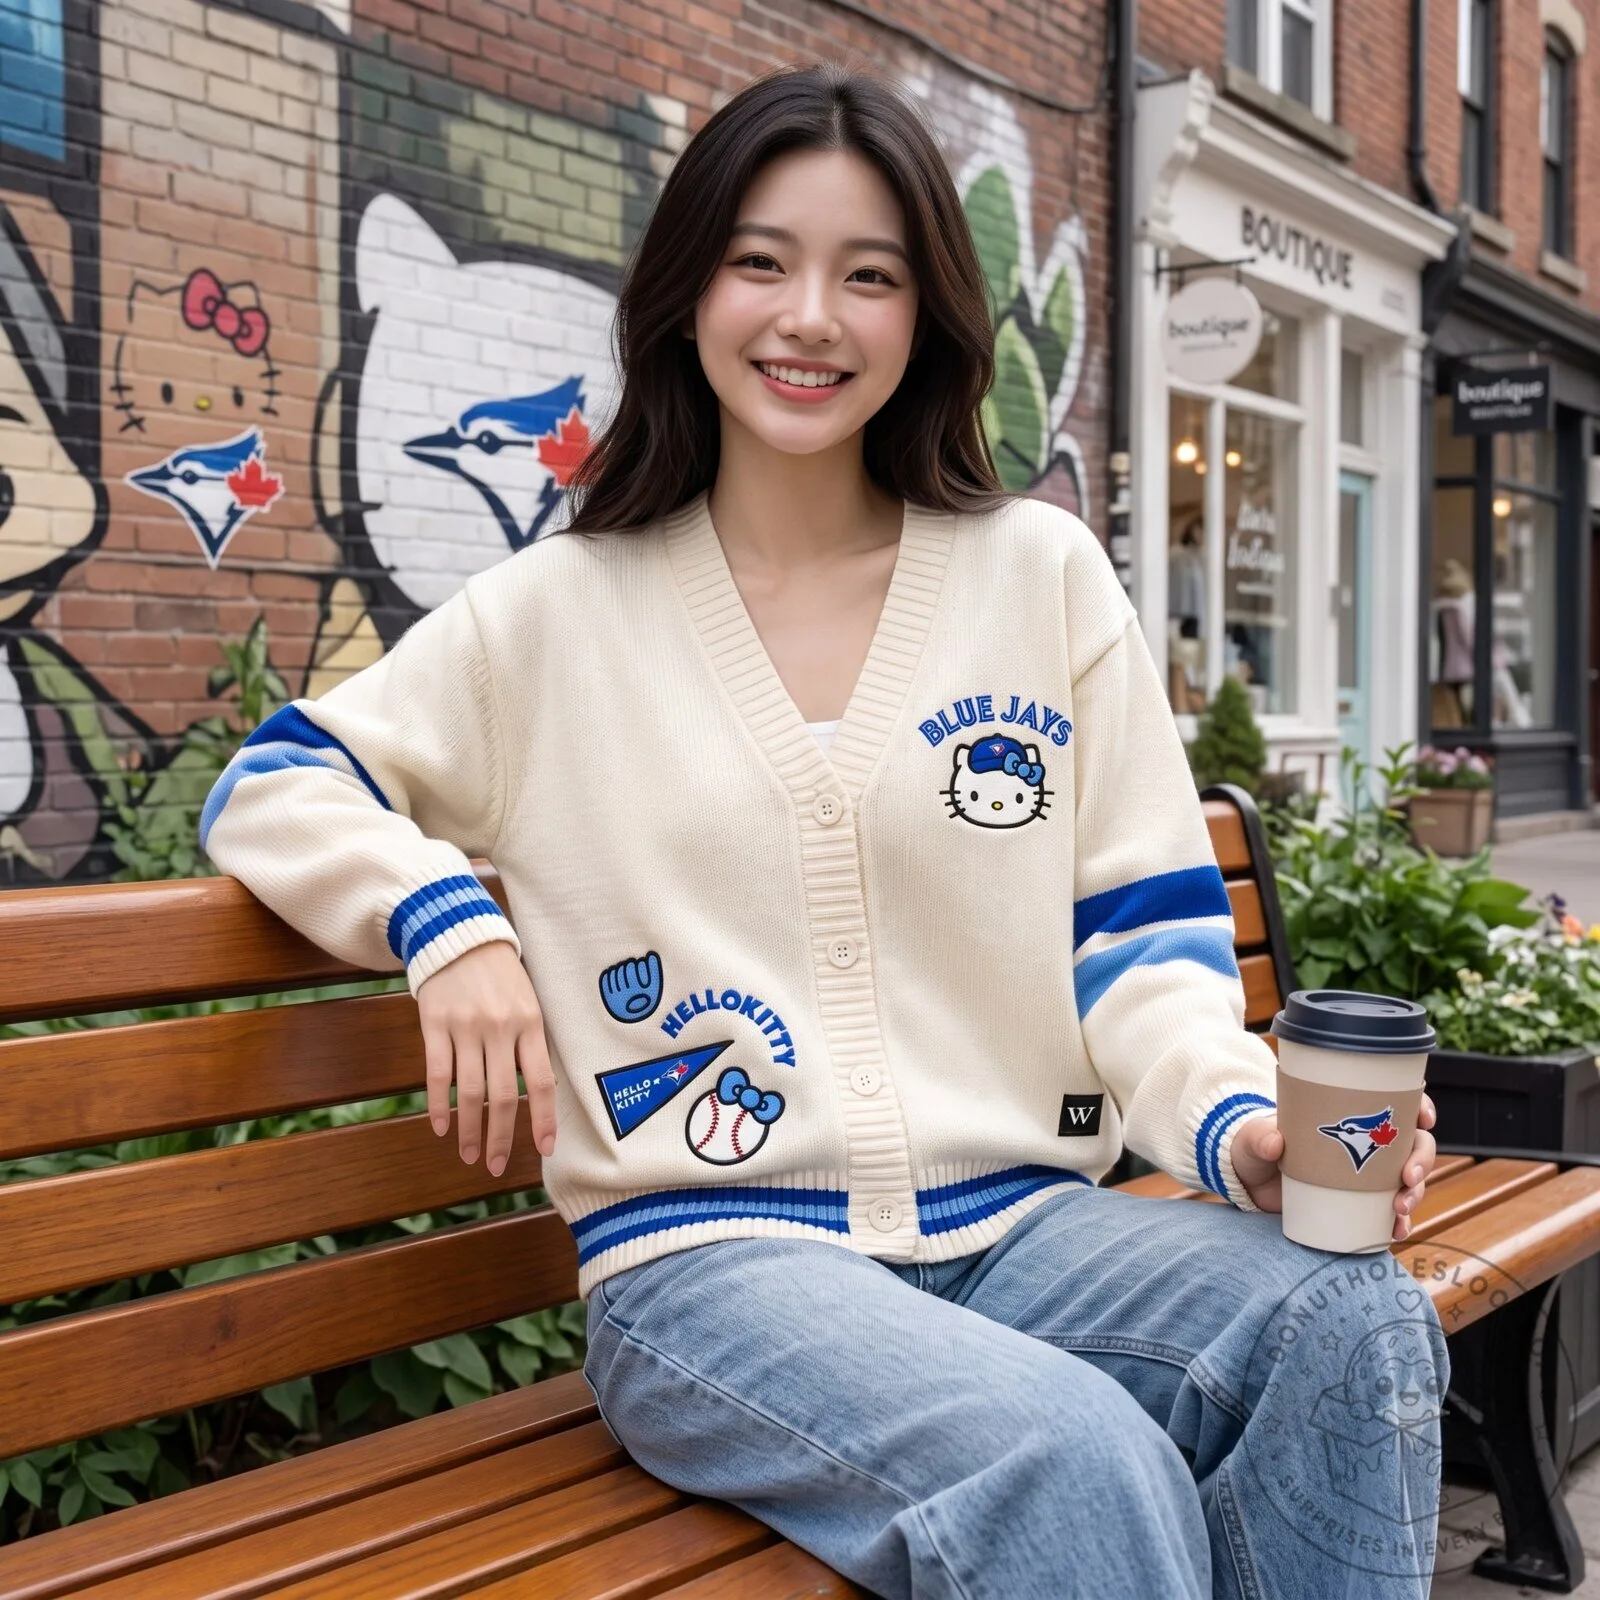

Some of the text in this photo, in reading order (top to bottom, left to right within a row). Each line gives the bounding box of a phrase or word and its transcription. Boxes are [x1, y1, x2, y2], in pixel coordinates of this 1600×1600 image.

[1241, 205, 1352, 290] BOUTIQUE
[1168, 315, 1249, 342] boutique
[1458, 378, 1544, 405] boutique
[918, 695, 1072, 747] BLUE JAYS
[660, 989, 796, 1067] HELLOKITTY
[613, 1079, 651, 1102] HELLO
[615, 1089, 651, 1112] KITTY
[1067, 1106, 1096, 1126] W
